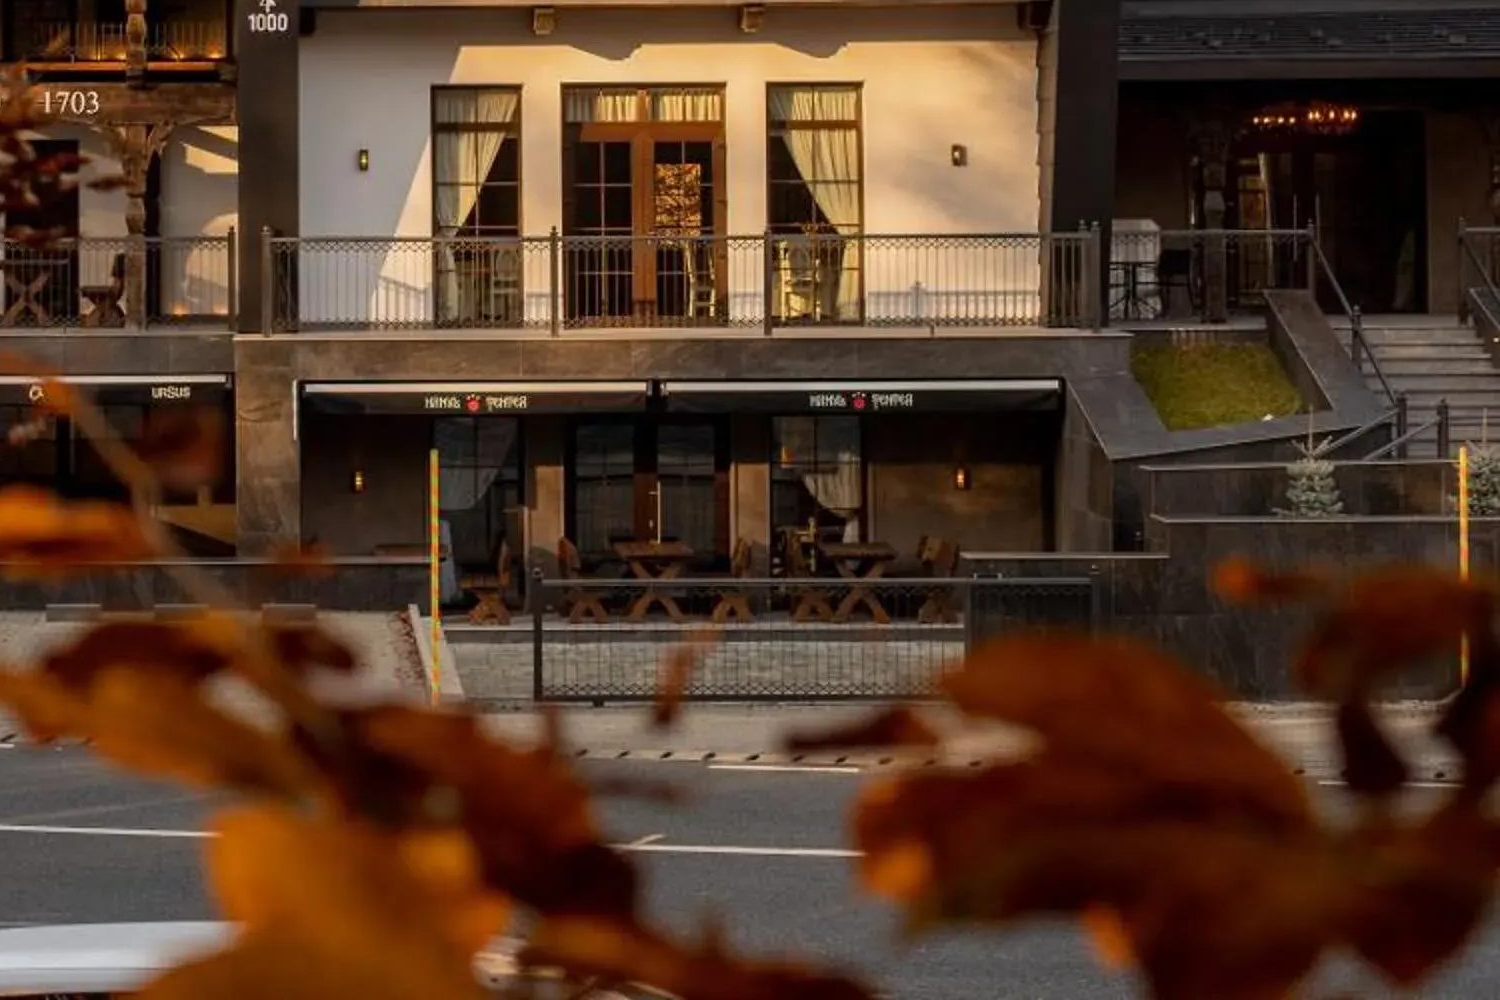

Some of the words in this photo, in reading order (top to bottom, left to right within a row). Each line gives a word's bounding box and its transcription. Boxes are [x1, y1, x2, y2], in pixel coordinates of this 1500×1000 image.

[247, 12, 289, 33] 1000
[42, 90, 100, 115] 1703
[151, 385, 191, 399] URSUS
